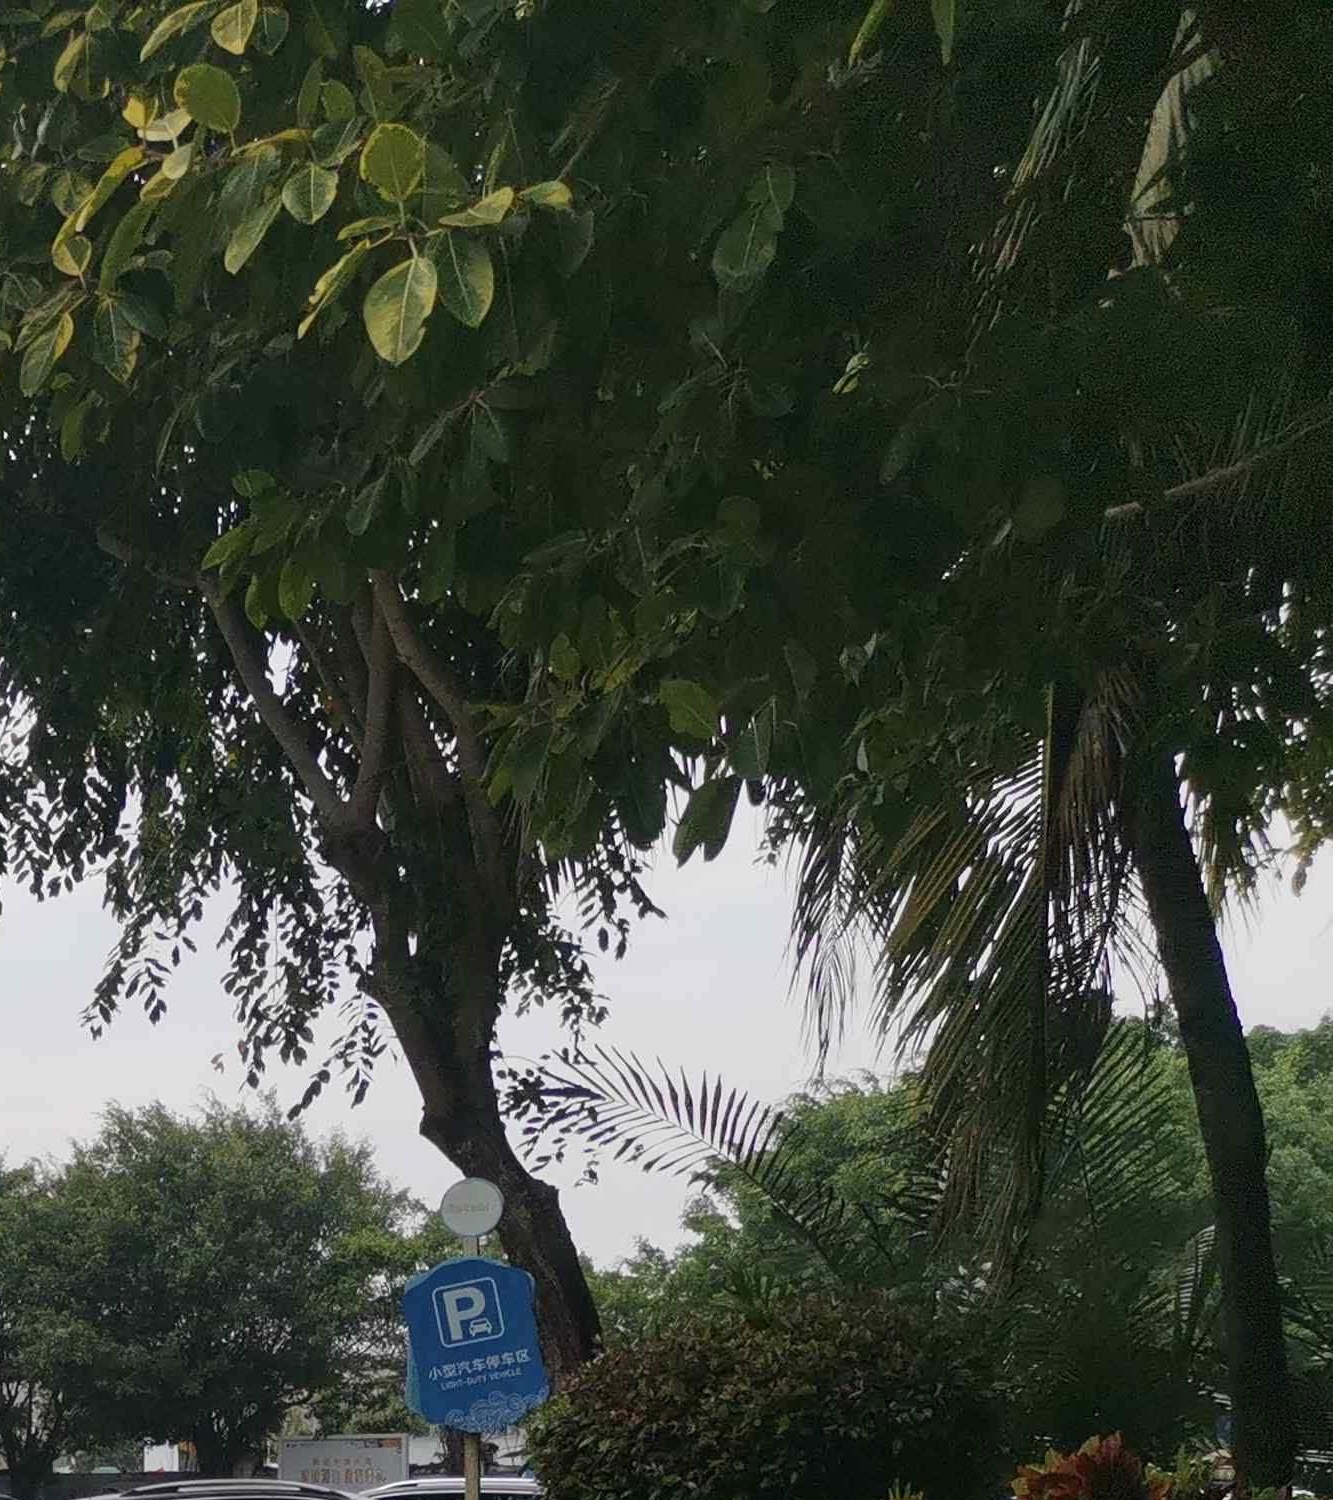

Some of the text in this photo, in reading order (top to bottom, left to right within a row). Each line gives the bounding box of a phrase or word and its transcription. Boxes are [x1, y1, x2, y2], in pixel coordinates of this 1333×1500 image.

[442, 1287, 486, 1341] P
[428, 1348, 532, 1382] 小型汽车停车区
[490, 1367, 523, 1381] VEHICLE
